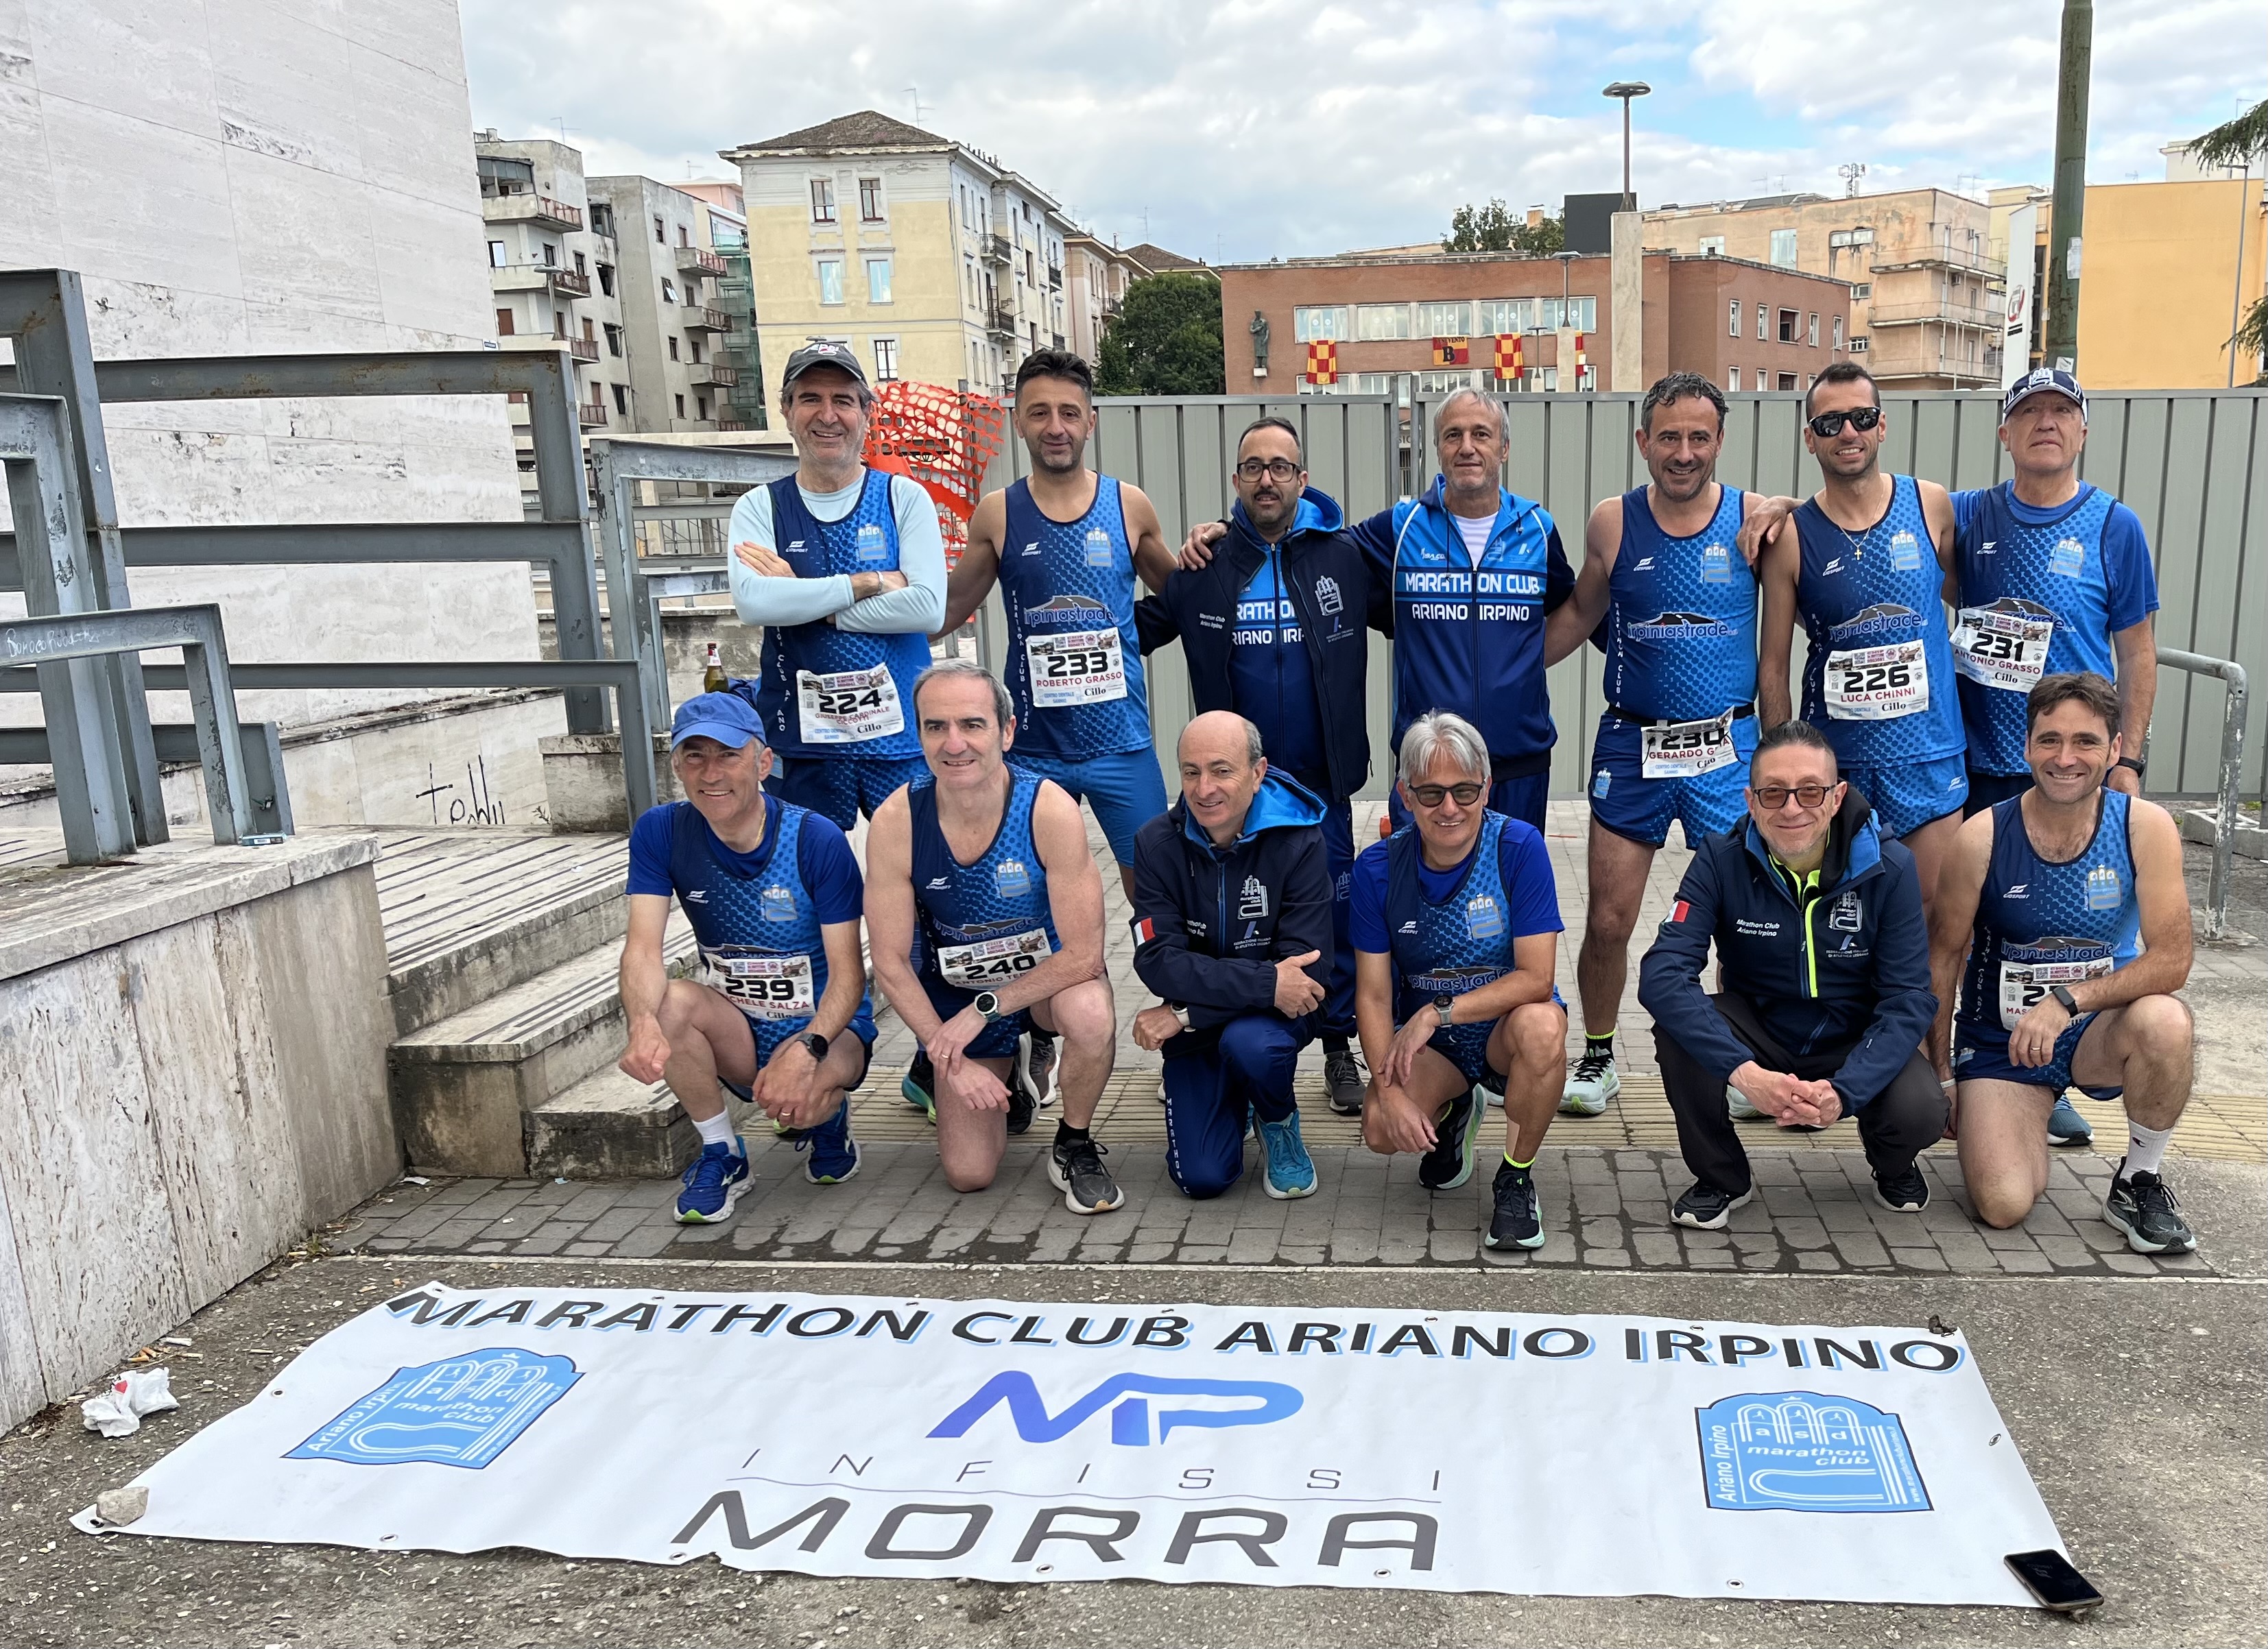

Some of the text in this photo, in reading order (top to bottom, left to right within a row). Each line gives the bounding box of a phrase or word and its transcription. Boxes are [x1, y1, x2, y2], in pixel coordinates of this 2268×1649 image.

[1406, 573, 1540, 594] MARATHON CLUB
[1237, 600, 1296, 621] RATHO
[1412, 603, 1529, 621] ARIANO IRPINO
[1232, 629, 1272, 646] RIANO
[1970, 631, 2025, 662] 231
[1047, 651, 1108, 677] 233
[1955, 648, 1995, 666] ANTONIO
[1998, 660, 2041, 675] GRASSO
[1036, 671, 1122, 687] ROBERTO GRASSO
[1843, 664, 1910, 693] 226
[1994, 671, 2018, 684] Cillo
[818, 689, 882, 714] 224
[1084, 687, 1106, 697] Cillo
[1840, 686, 1915, 703] LUCA CHINNI
[1881, 701, 1907, 712] Cillo
[857, 723, 882, 734] Cillo
[1661, 728, 1725, 750] 230
[1649, 748, 1704, 760] GERARDO
[1736, 919, 1764, 928] Marathon
[1736, 927, 1757, 935] Ariano
[965, 954, 1037, 980] 240
[726, 977, 795, 1000] 239
[955, 976, 1004, 986] ANTONIO
[769, 1001, 809, 1010] SALZA
[1167, 1098, 1182, 1179] MARATHON
[386, 1292, 1959, 1371] MARATHON CLUB ARIANO IRPINO
[393, 1399, 506, 1415] marathon
[926, 1370, 1304, 1447] MP
[442, 1410, 496, 1424] club
[307, 1410, 363, 1452] Ariano
[1747, 1445, 1867, 1458] marathon
[1815, 1456, 1870, 1466] club
[741, 1448, 1440, 1491] INFISSI
[1708, 1425, 1738, 1503] Ariano Irpino
[671, 1491, 1438, 1570] MORRA
